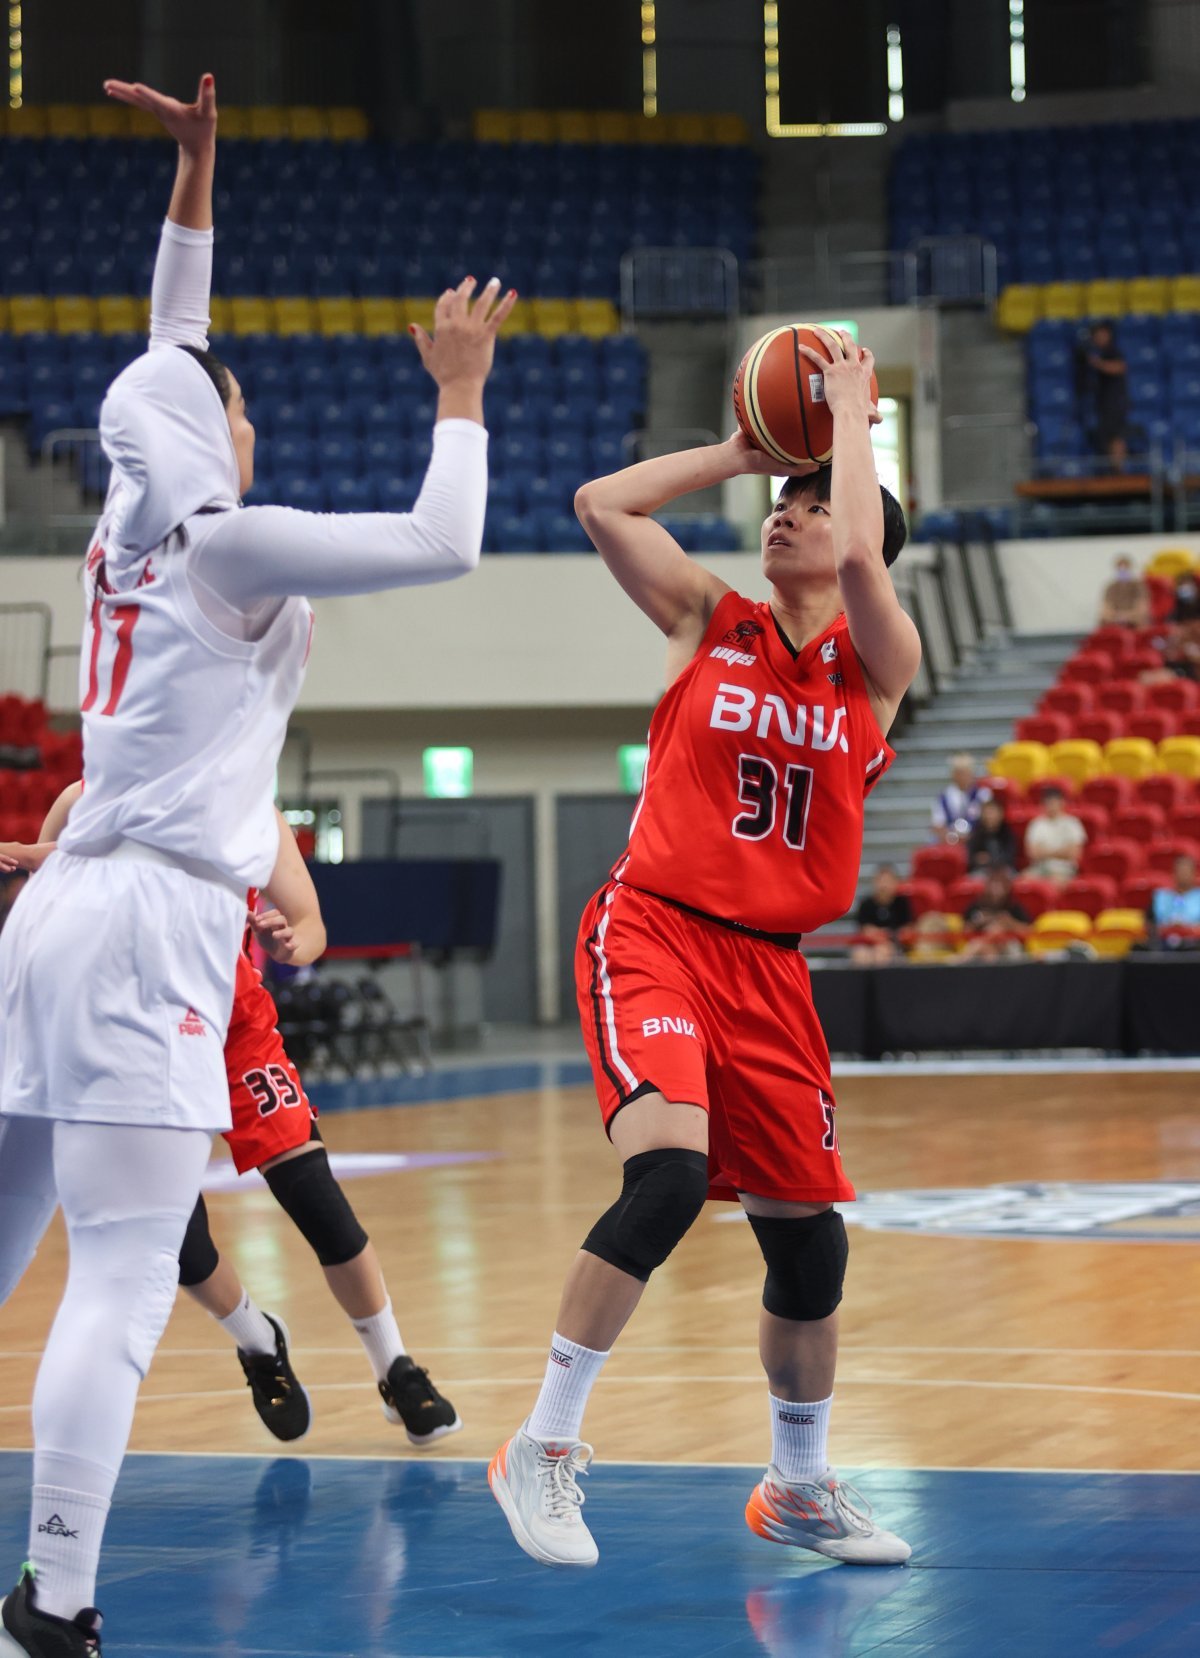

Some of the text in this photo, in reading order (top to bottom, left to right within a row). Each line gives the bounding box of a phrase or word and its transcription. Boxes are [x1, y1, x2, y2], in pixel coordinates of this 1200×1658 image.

[732, 753, 814, 851] 31
[242, 1064, 301, 1118] 33
[37, 1524, 80, 1539] PEAK
